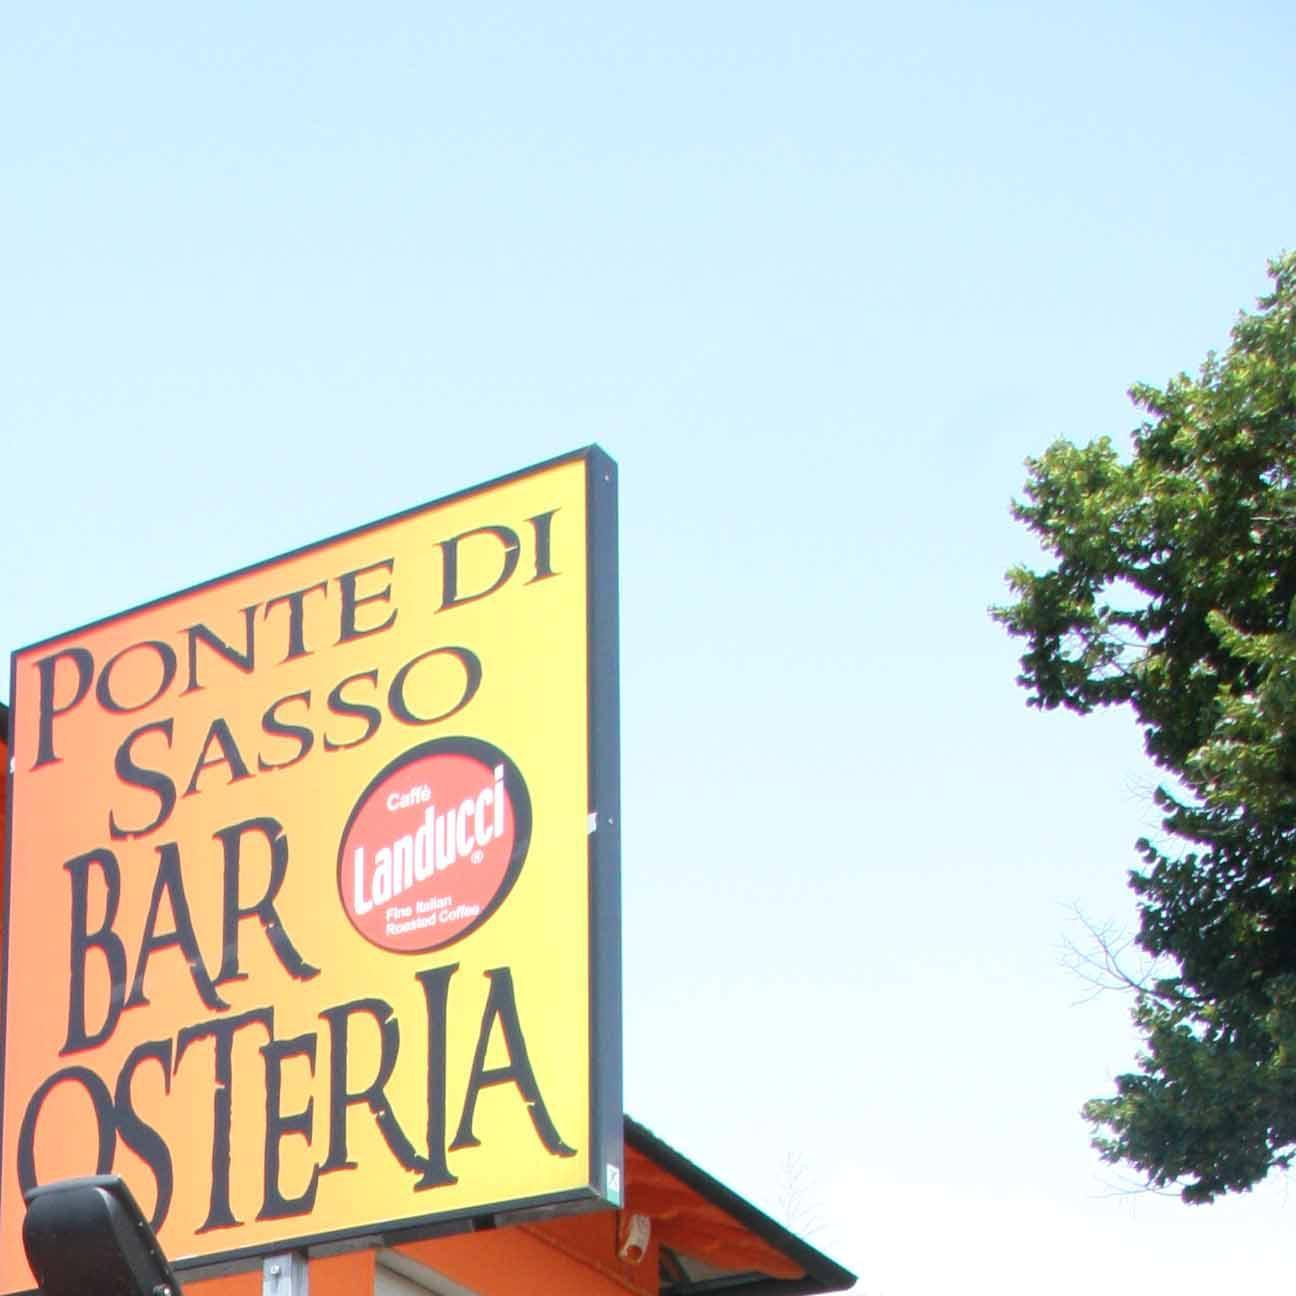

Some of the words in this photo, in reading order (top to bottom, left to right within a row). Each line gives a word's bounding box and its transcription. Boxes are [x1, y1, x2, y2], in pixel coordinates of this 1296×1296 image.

[30, 558, 399, 773] PONTE
[435, 507, 565, 614] DI
[108, 645, 484, 842] SASSO
[387, 785, 432, 811] Caffè
[353, 763, 504, 916] Landucci
[385, 905, 413, 922] Fine
[416, 895, 453, 915] Italian
[385, 913, 437, 936] Roasted
[439, 903, 481, 923] Coffee
[58, 816, 321, 1059] BAR
[16, 961, 578, 1236] OSTERIA
